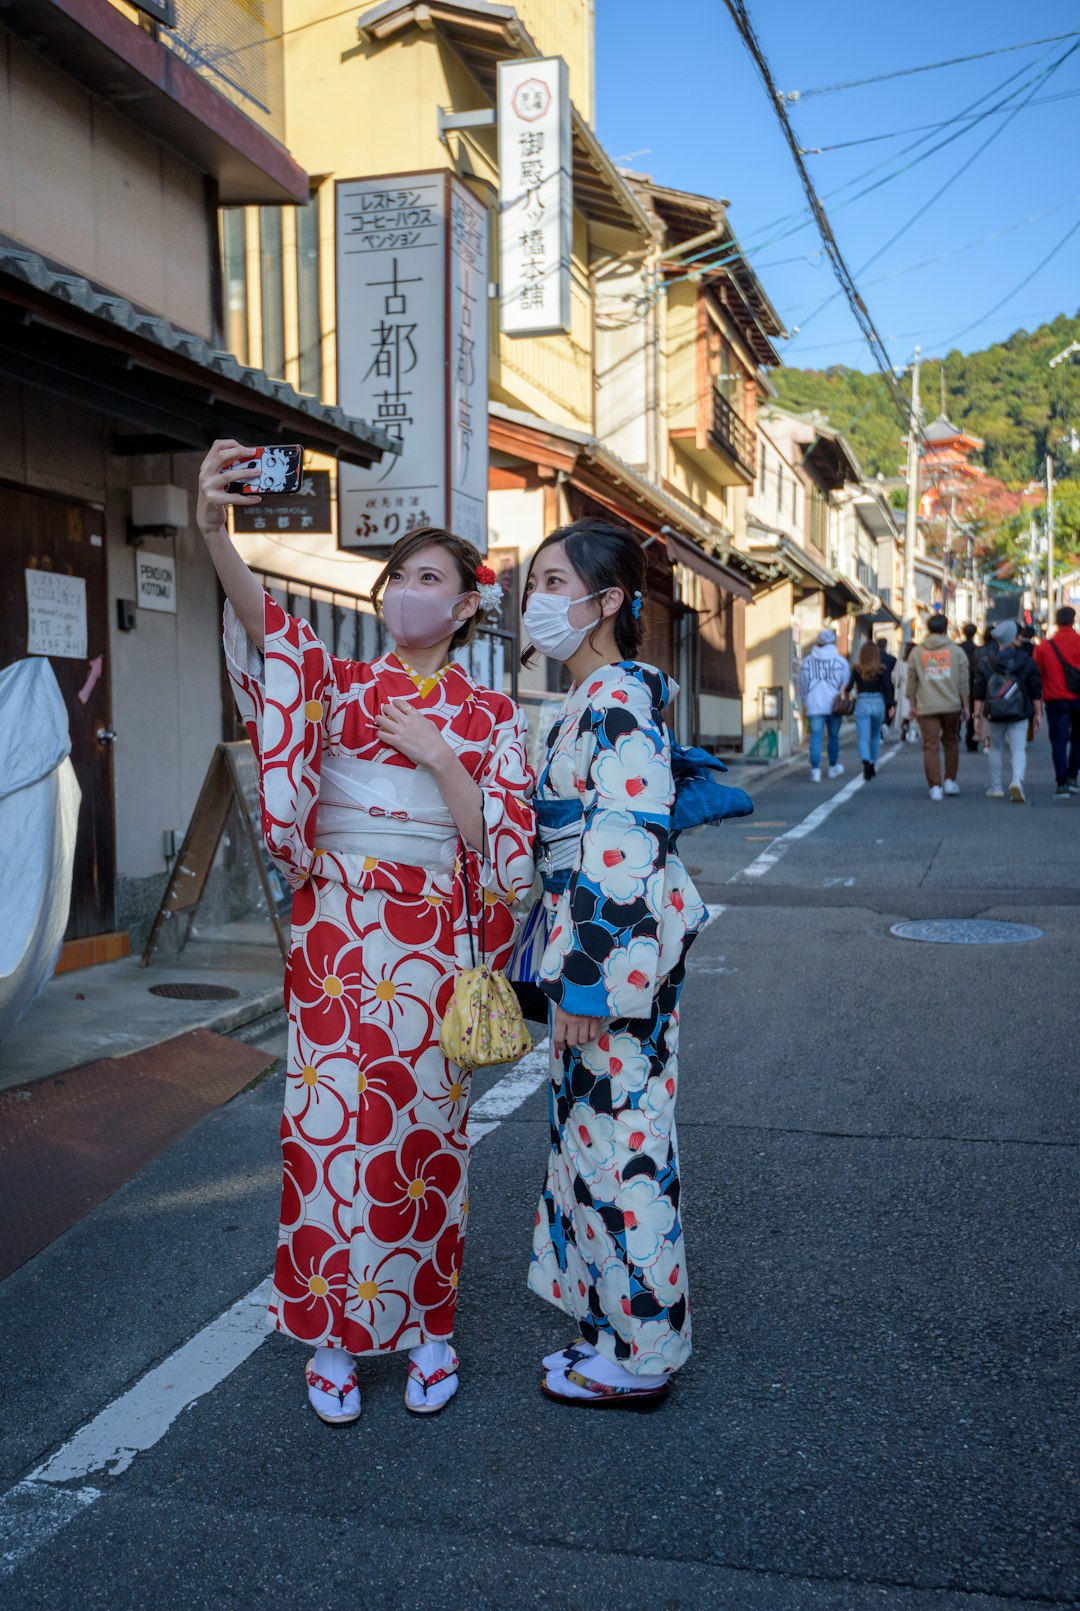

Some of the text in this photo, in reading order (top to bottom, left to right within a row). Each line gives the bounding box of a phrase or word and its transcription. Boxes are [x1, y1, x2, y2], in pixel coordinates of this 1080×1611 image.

[361, 191, 421, 211] レストラン
[352, 209, 432, 232] コーヒーハウス
[361, 257, 424, 483] 古都夢
[141, 563, 173, 584] PENSION
[141, 581, 171, 600] KOTOMU
